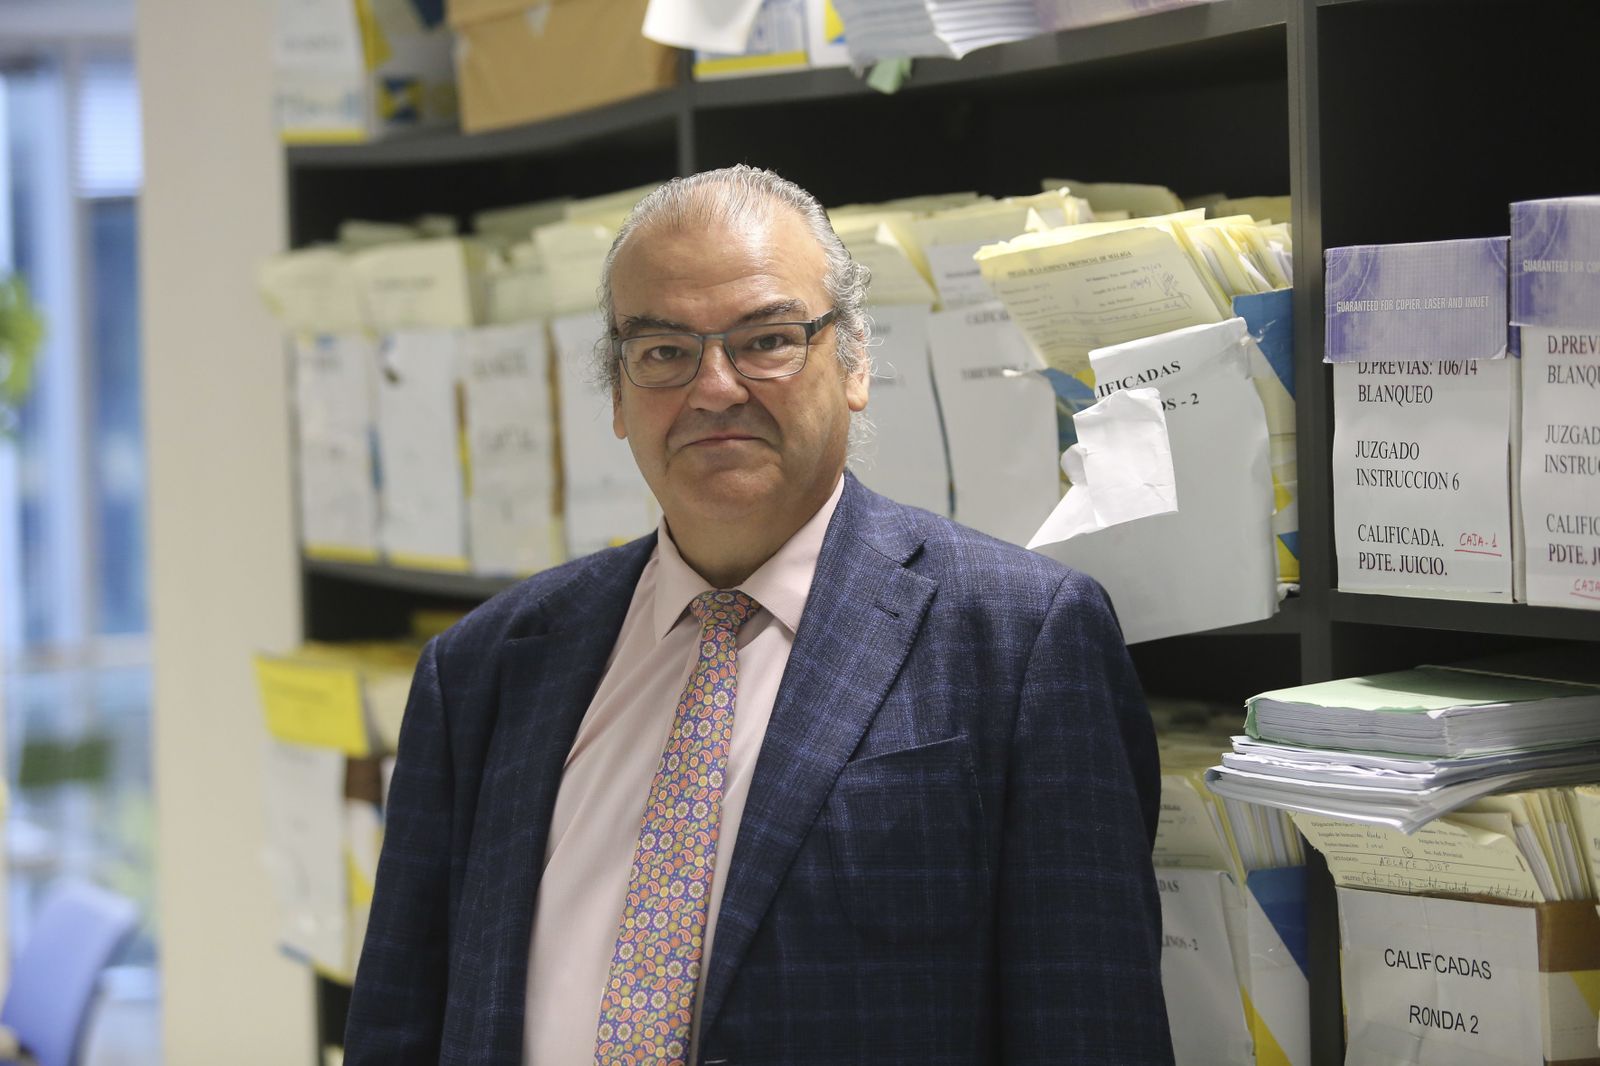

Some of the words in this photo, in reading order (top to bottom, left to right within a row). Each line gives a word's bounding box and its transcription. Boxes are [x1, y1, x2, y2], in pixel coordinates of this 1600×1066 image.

[1523, 260, 1569, 273] GUARANTEED
[1570, 261, 1585, 273] FOR
[1336, 300, 1379, 313] GUARANTEED
[1381, 299, 1394, 312] FOR
[1424, 297, 1446, 310] LASER
[1447, 296, 1463, 309] AND
[1465, 295, 1489, 308] INKJET
[1547, 334, 1600, 355] D.PREV
[1357, 360, 1433, 375] D.PREVIAS:
[1437, 359, 1478, 376] 106/14
[1547, 364, 1600, 389] BLANQ
[1096, 360, 1181, 399] IFICADAS
[1190, 393, 1199, 405] 2
[1357, 384, 1433, 407] BLANQUEO
[1355, 440, 1420, 461] JUZGADO
[1544, 454, 1600, 476] INSTRU
[1356, 468, 1449, 490] INSTRUCCION
[1452, 472, 1460, 491] 6
[1357, 523, 1445, 547] CALIFICADA.
[1358, 552, 1396, 572] PDTE.
[1399, 554, 1449, 577] JUICIO.
[1548, 543, 1588, 565] PDTE.
[1591, 546, 1600, 566] J
[1383, 947, 1493, 980] CALIFCADAS
[1408, 1005, 1466, 1033] RONDA
[1470, 1015, 1480, 1034] 2
